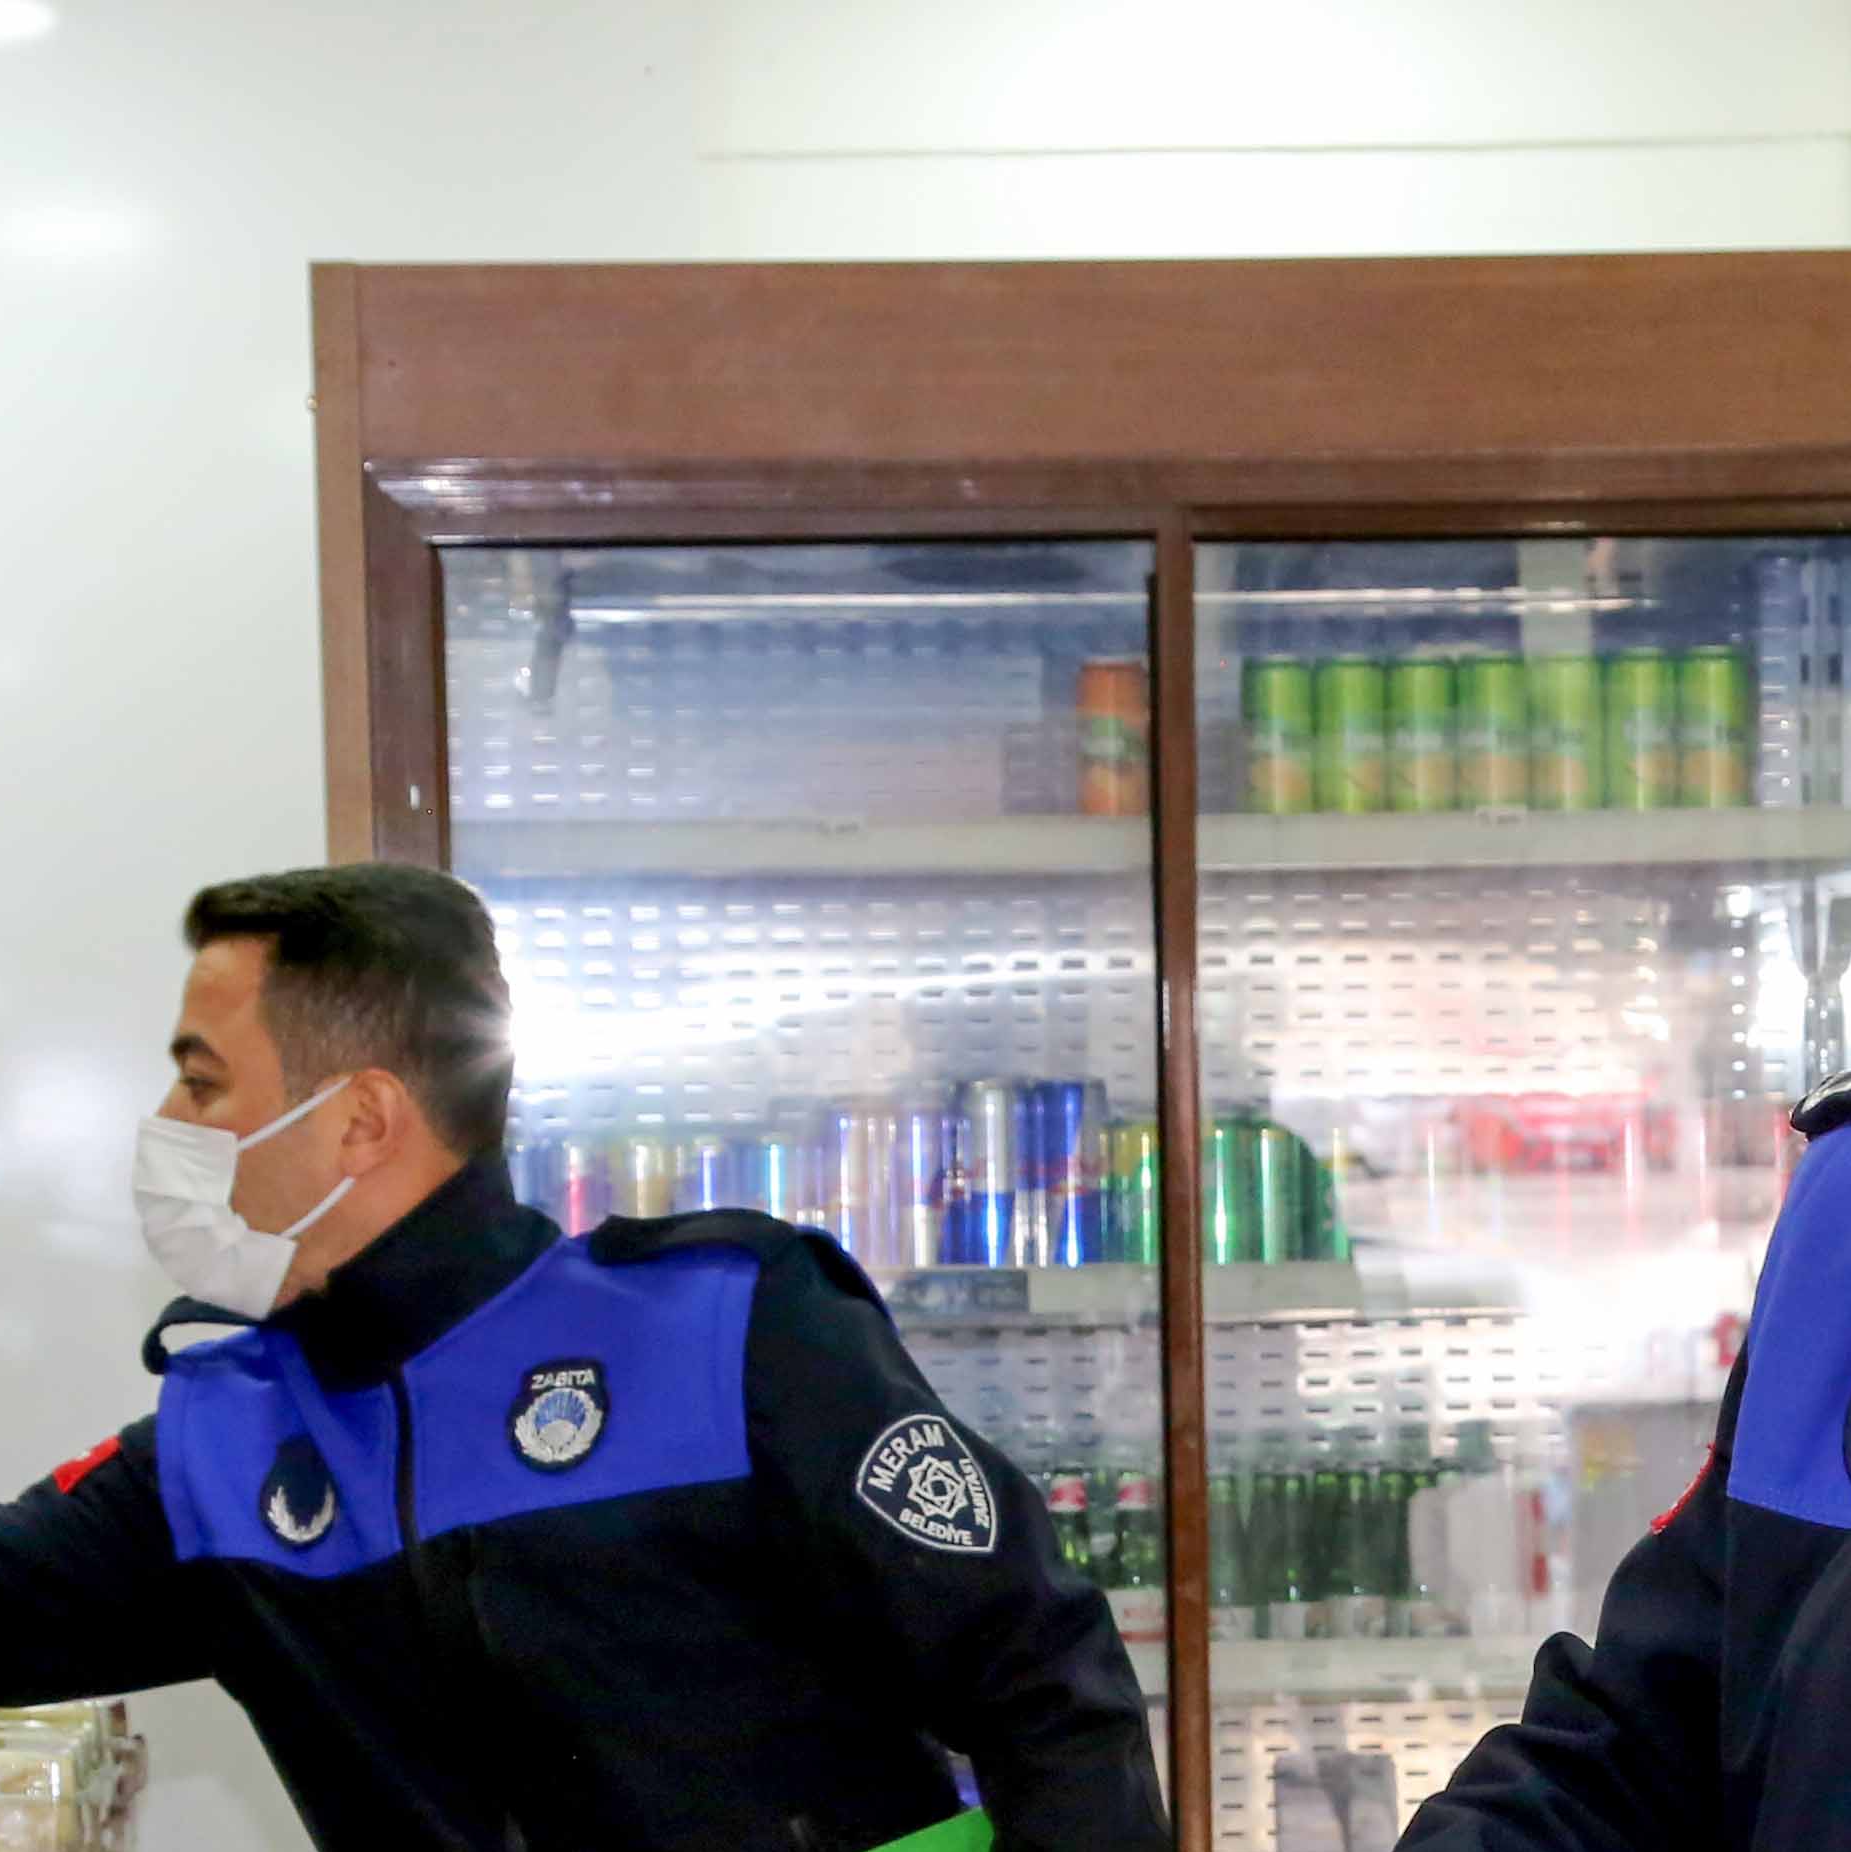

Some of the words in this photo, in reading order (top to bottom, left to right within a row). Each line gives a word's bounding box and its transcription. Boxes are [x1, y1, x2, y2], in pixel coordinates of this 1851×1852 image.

[531, 1368, 595, 1390] ZABITA
[868, 1423, 945, 1493] MERAM
[898, 1507, 973, 1546] BELEDİYE
